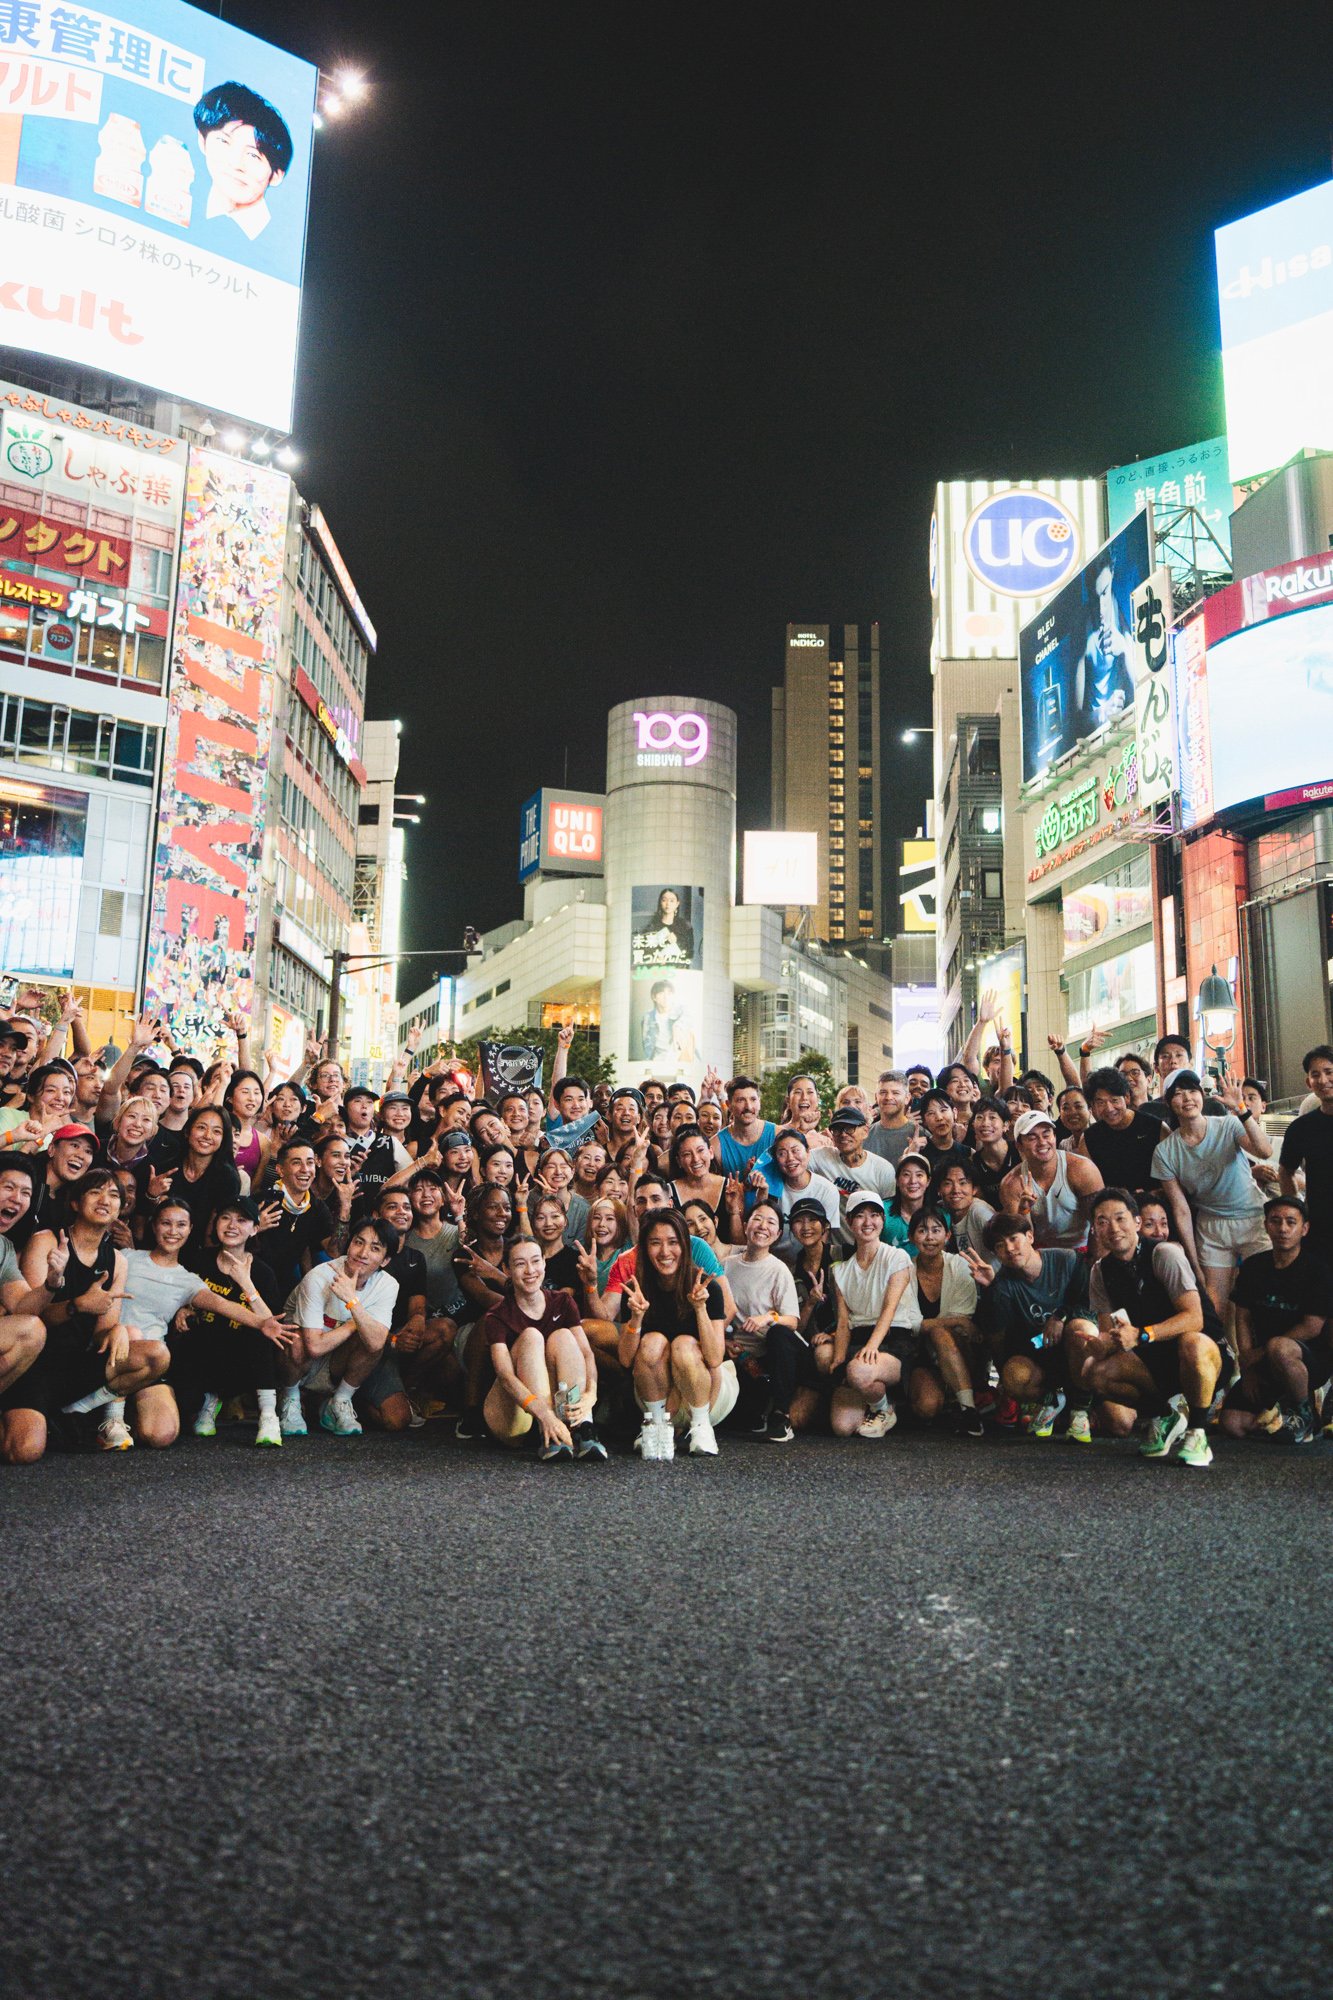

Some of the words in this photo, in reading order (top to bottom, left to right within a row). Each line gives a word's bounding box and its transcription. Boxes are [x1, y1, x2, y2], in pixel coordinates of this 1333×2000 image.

[64, 448, 172, 506] しゃぶ葉
[66, 589, 150, 634] ガスト
[1037, 616, 1055, 640] BLEU
[790, 639, 825, 647] INDIGO
[1035, 637, 1059, 665] CHANEL
[1136, 585, 1173, 789] もんじゃ
[633, 712, 708, 766] 109
[636, 753, 682, 767] SHIBUYA
[554, 808, 593, 832] UNI
[1061, 791, 1097, 842] 西村
[553, 831, 596, 854] QLO
[833, 1176, 860, 1193] NIKE
